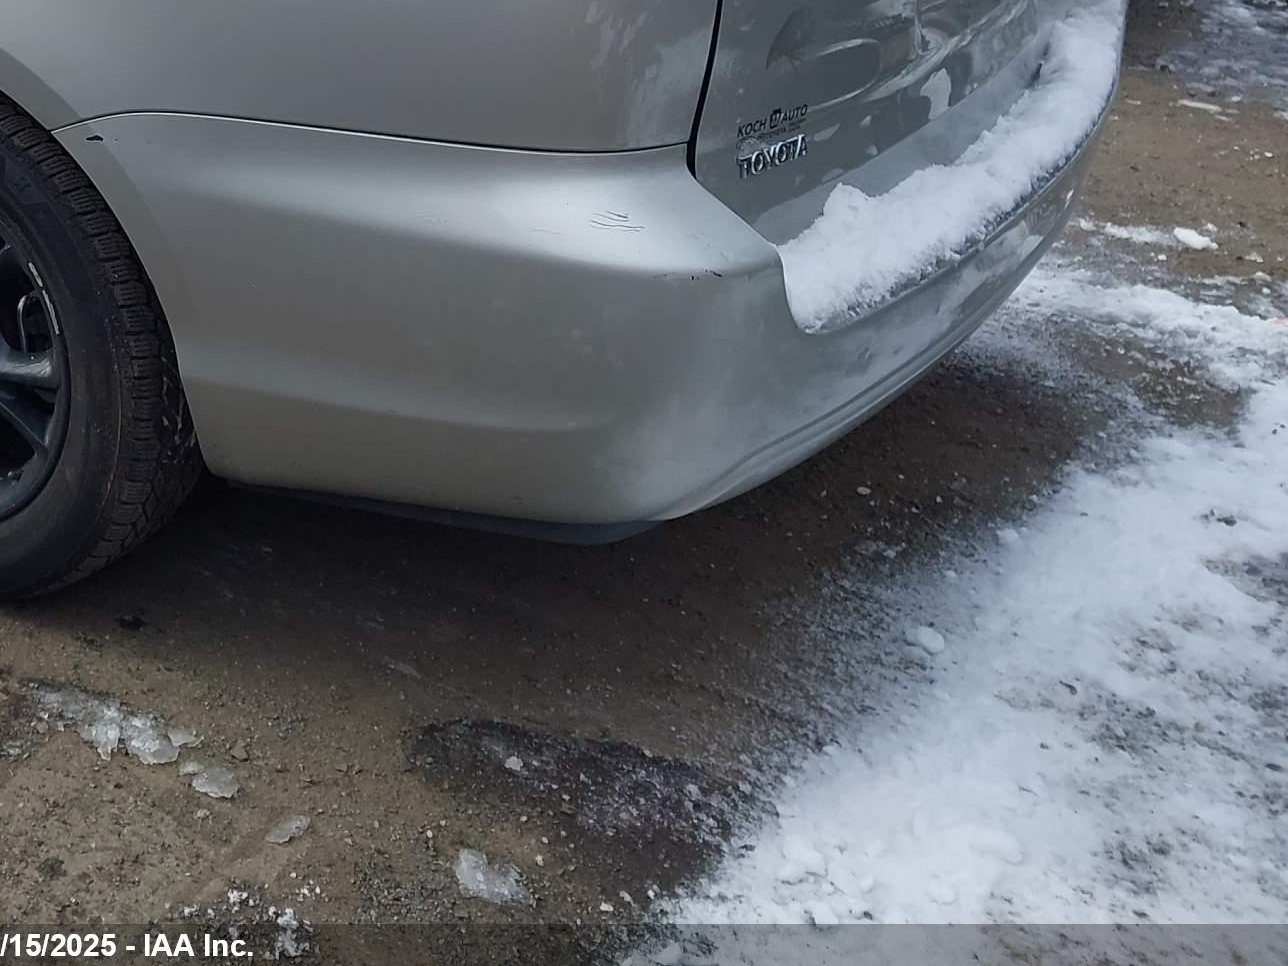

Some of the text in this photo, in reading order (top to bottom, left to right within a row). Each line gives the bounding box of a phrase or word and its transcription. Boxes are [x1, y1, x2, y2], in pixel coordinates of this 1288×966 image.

[736, 117, 768, 138] KOCH
[780, 103, 808, 124] AUTO
[736, 133, 808, 179] TOYOTA
